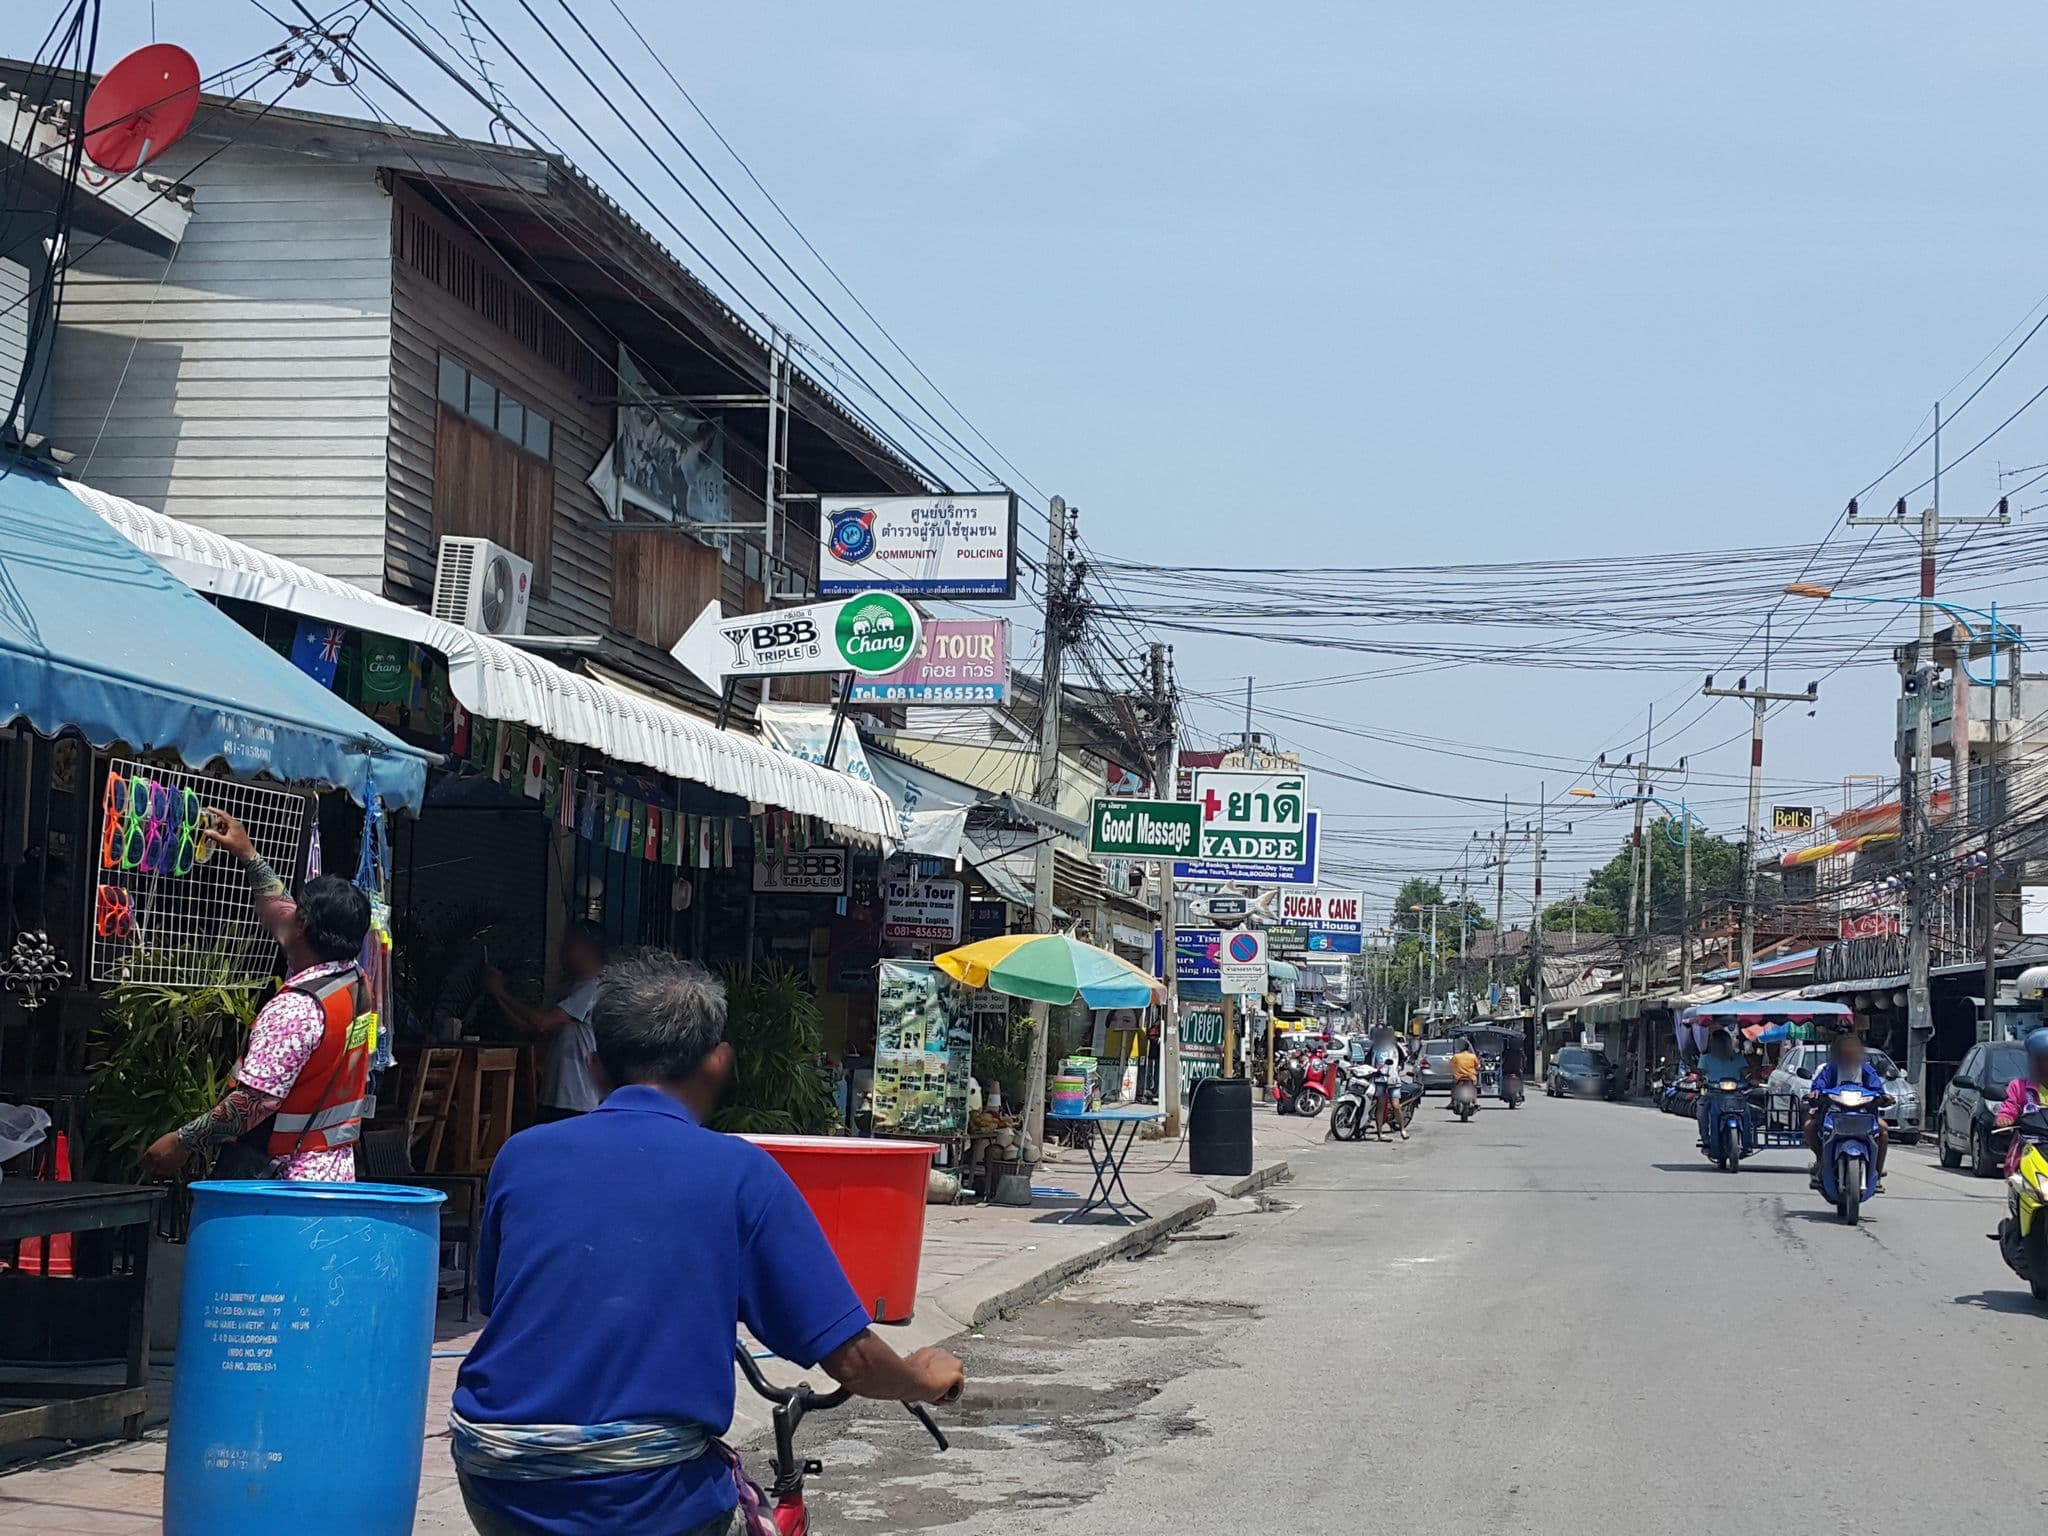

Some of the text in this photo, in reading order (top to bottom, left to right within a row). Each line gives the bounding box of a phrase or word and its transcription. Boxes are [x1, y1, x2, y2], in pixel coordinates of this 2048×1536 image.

[911, 503, 977, 523] ศูนย์บริการ
[881, 519, 997, 542] ตำรวจผู้รับใช้ชุมชน
[876, 549, 1003, 560] COMMUNITY POLICING
[752, 620, 818, 650] BBB
[847, 635, 905, 655] Chang
[756, 646, 818, 664] TRIPLE B
[936, 635, 995, 662] TOUR
[369, 662, 401, 674] Chang
[922, 660, 994, 678] ต้อย ทัวร์
[855, 687, 994, 700] Tel. 081-8565523
[1228, 782, 1302, 824] ยาดี
[1775, 810, 1811, 828] Bell's
[1102, 811, 1190, 852] Good Massage
[1203, 836, 1298, 859] YADEE
[783, 855, 842, 876] BBB
[783, 876, 829, 886] TRIPLE
[924, 884, 955, 900] Tour
[1284, 896, 1358, 919] SUGAR CANE
[894, 926, 952, 938] 081-8565523
[1322, 921, 1357, 931] House
[1180, 1012, 1223, 1044] ขายยา
